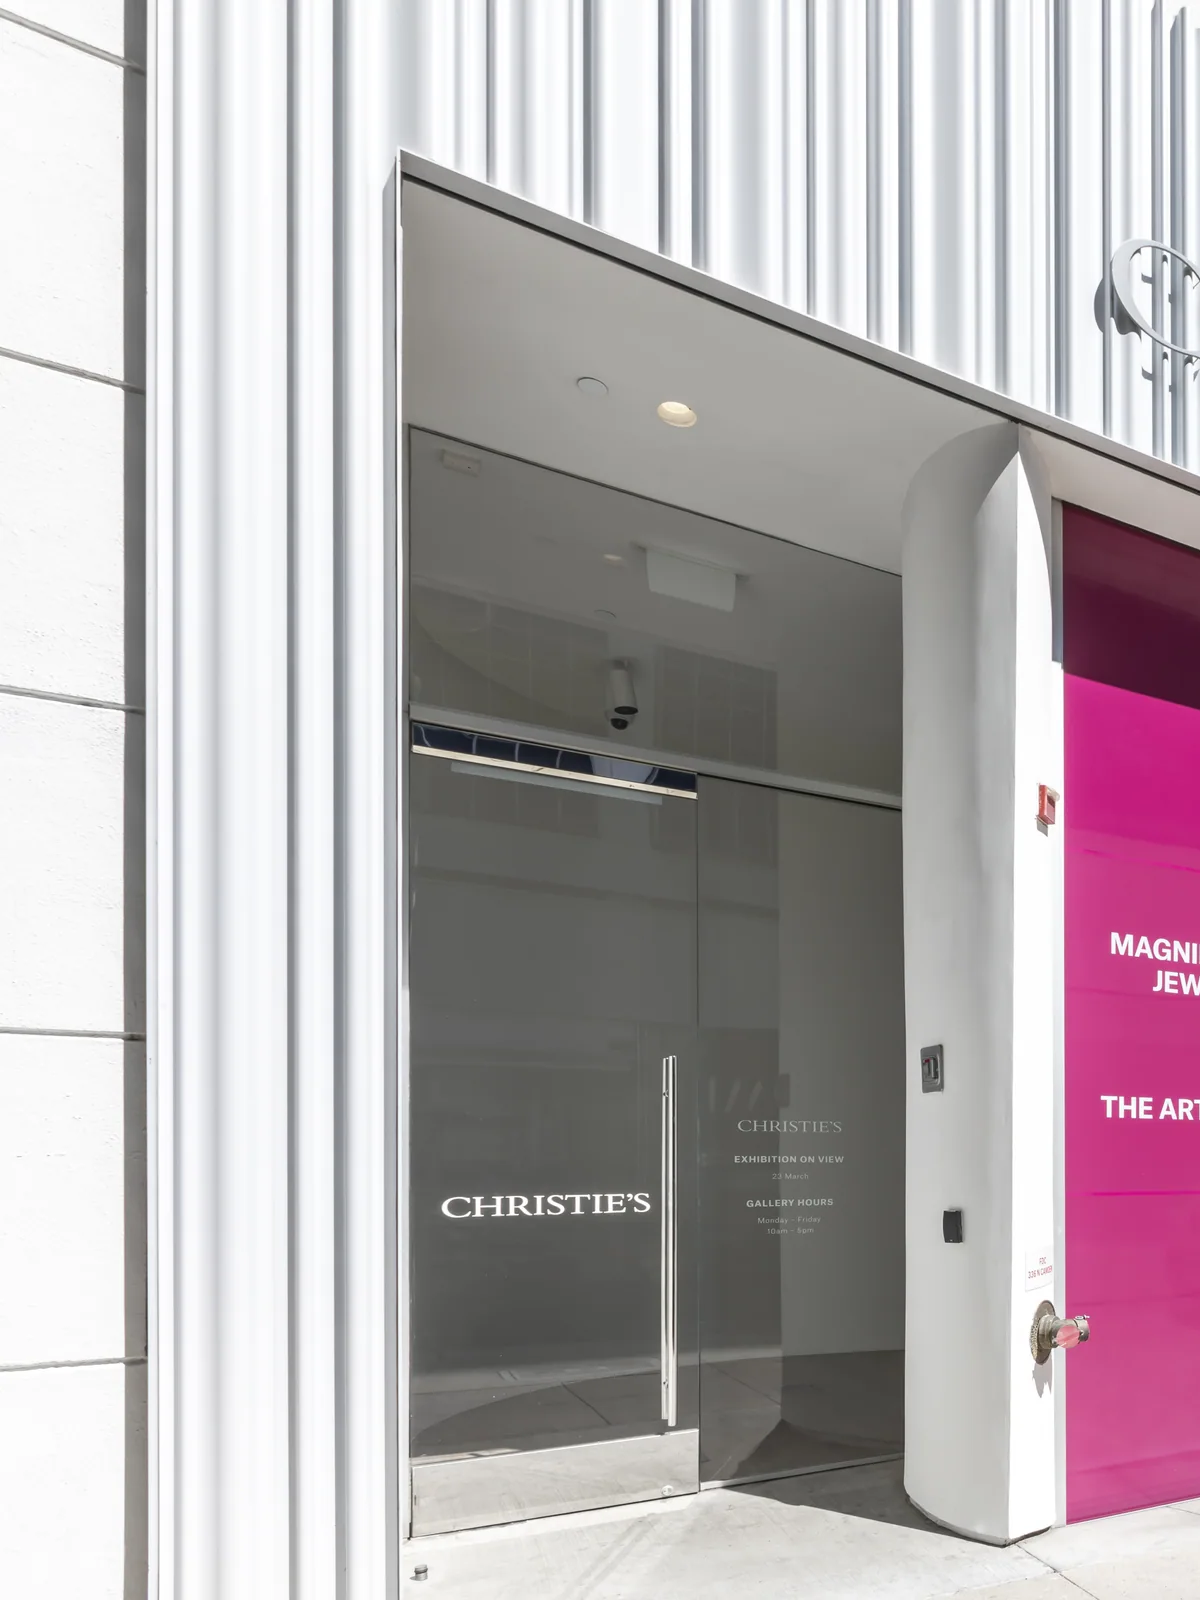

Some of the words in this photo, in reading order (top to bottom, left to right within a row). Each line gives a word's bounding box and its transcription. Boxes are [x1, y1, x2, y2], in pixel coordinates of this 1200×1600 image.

[1100, 1095, 1153, 1120] THE
[737, 1119, 843, 1133] CHRISTIE'S
[734, 1155, 797, 1164] EXHIBITION
[799, 1155, 815, 1164] ON
[817, 1155, 845, 1164] VIEW
[784, 1172, 809, 1180] March
[440, 1192, 651, 1219] CHRISTIE'S
[746, 1199, 795, 1208] GALLERY
[797, 1198, 834, 1207] HOURS
[757, 1216, 789, 1225] Monday
[797, 1215, 822, 1224] Friday
